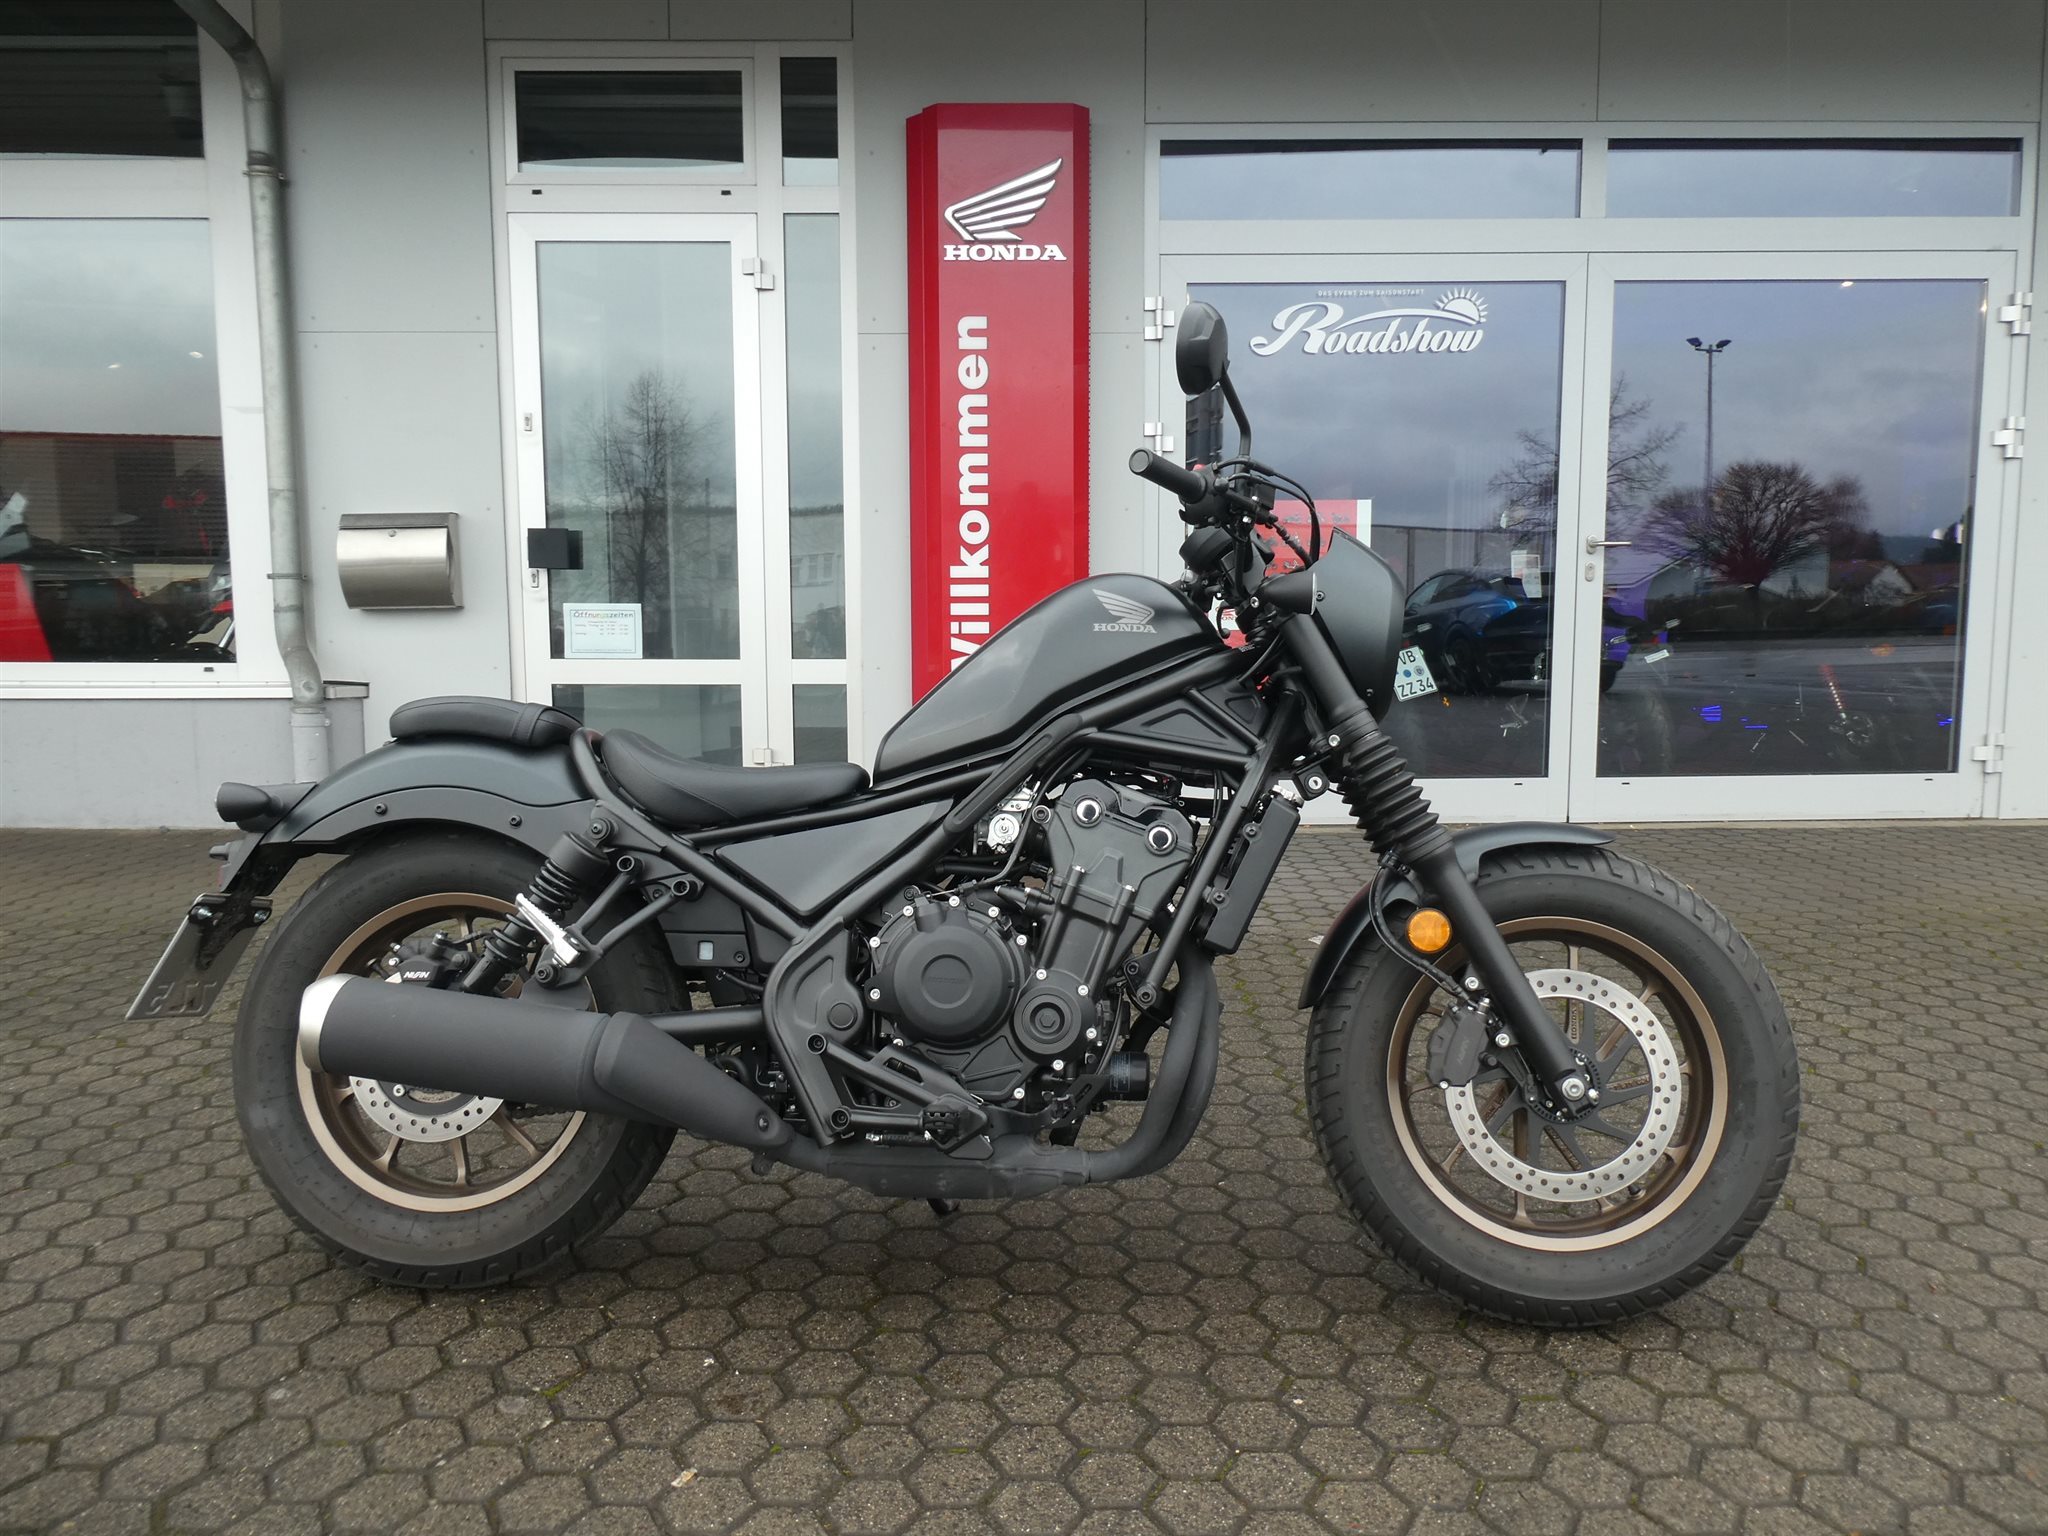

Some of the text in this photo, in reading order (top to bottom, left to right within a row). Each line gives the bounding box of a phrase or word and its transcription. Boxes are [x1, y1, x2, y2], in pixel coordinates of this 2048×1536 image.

[943, 244, 1067, 261] HONDA
[1376, 288, 1425, 296] SAISONSTART
[1249, 301, 1485, 357] Roadshow
[573, 610, 634, 618] Öffnunzeiten
[1093, 622, 1158, 634] HONDA
[1398, 650, 1416, 665] VB
